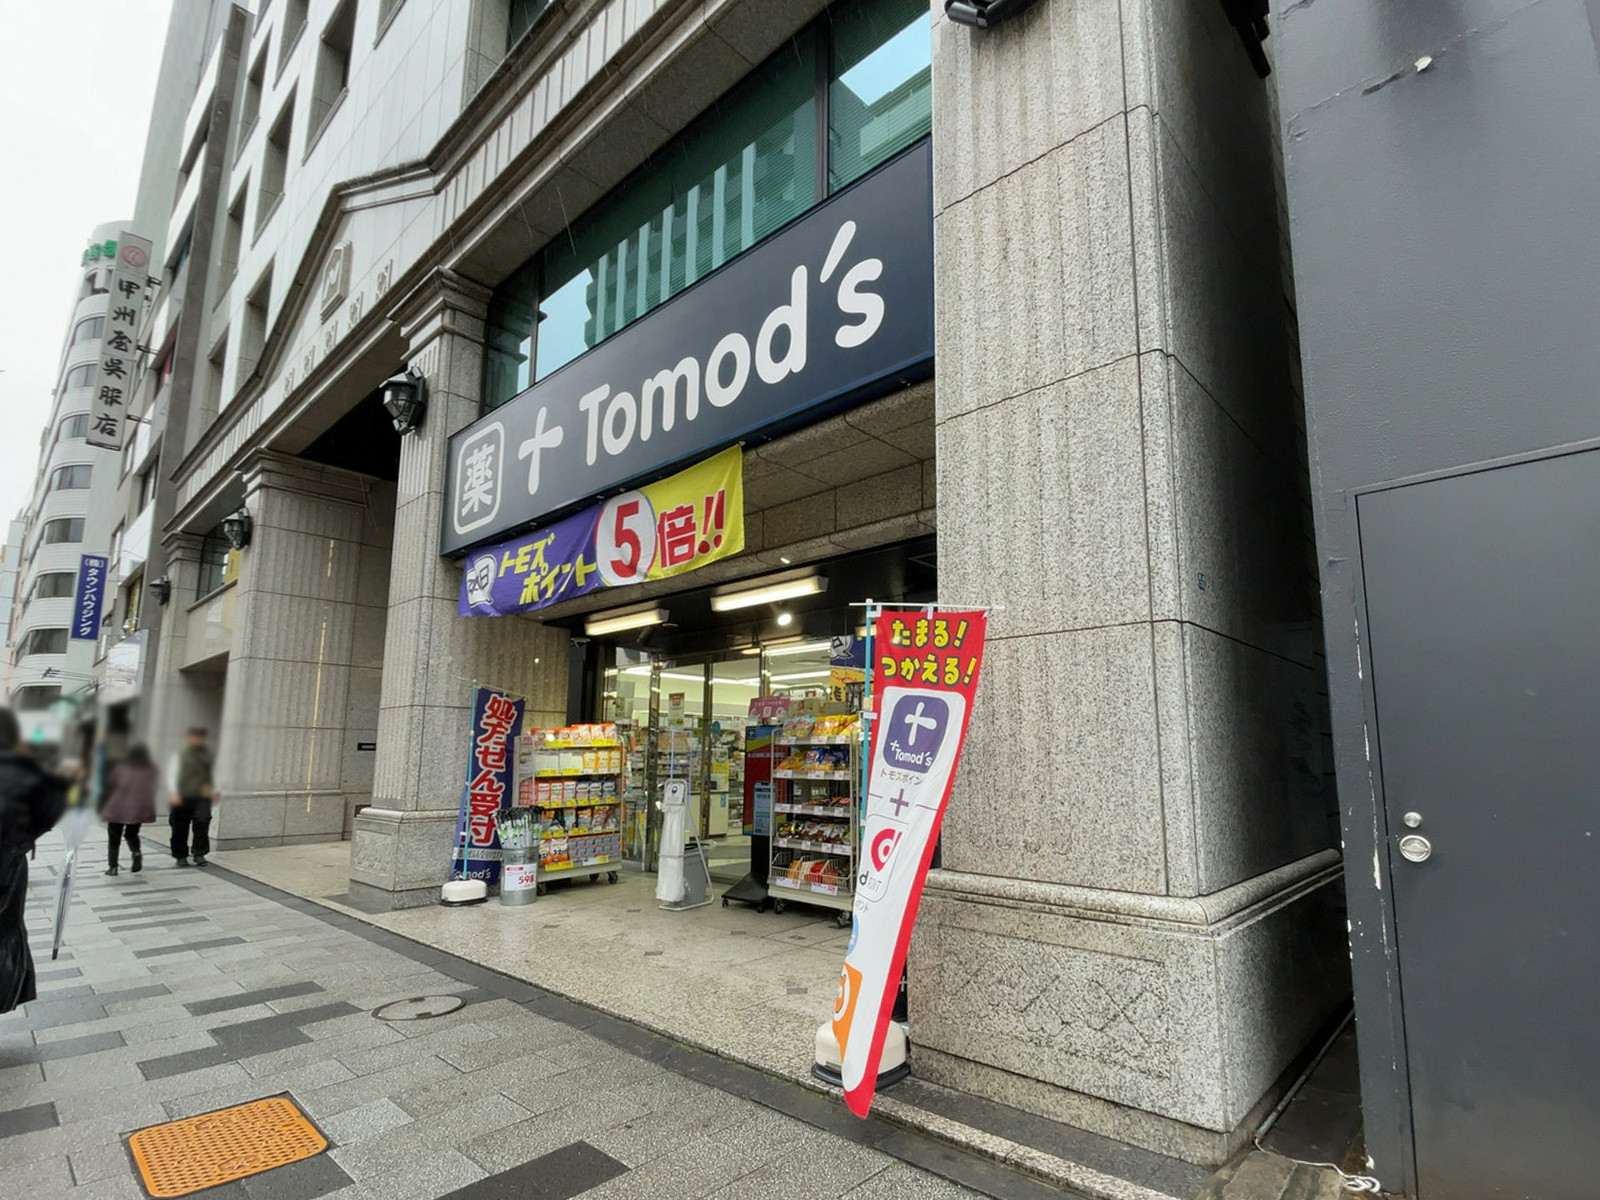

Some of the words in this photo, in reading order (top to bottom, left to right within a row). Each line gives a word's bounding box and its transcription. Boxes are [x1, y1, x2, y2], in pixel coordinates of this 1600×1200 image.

[579, 220, 886, 467] Tomod's
[462, 442, 495, 518] 薬
[518, 553, 598, 606] ポイント
[895, 748, 933, 767] Tomod's
